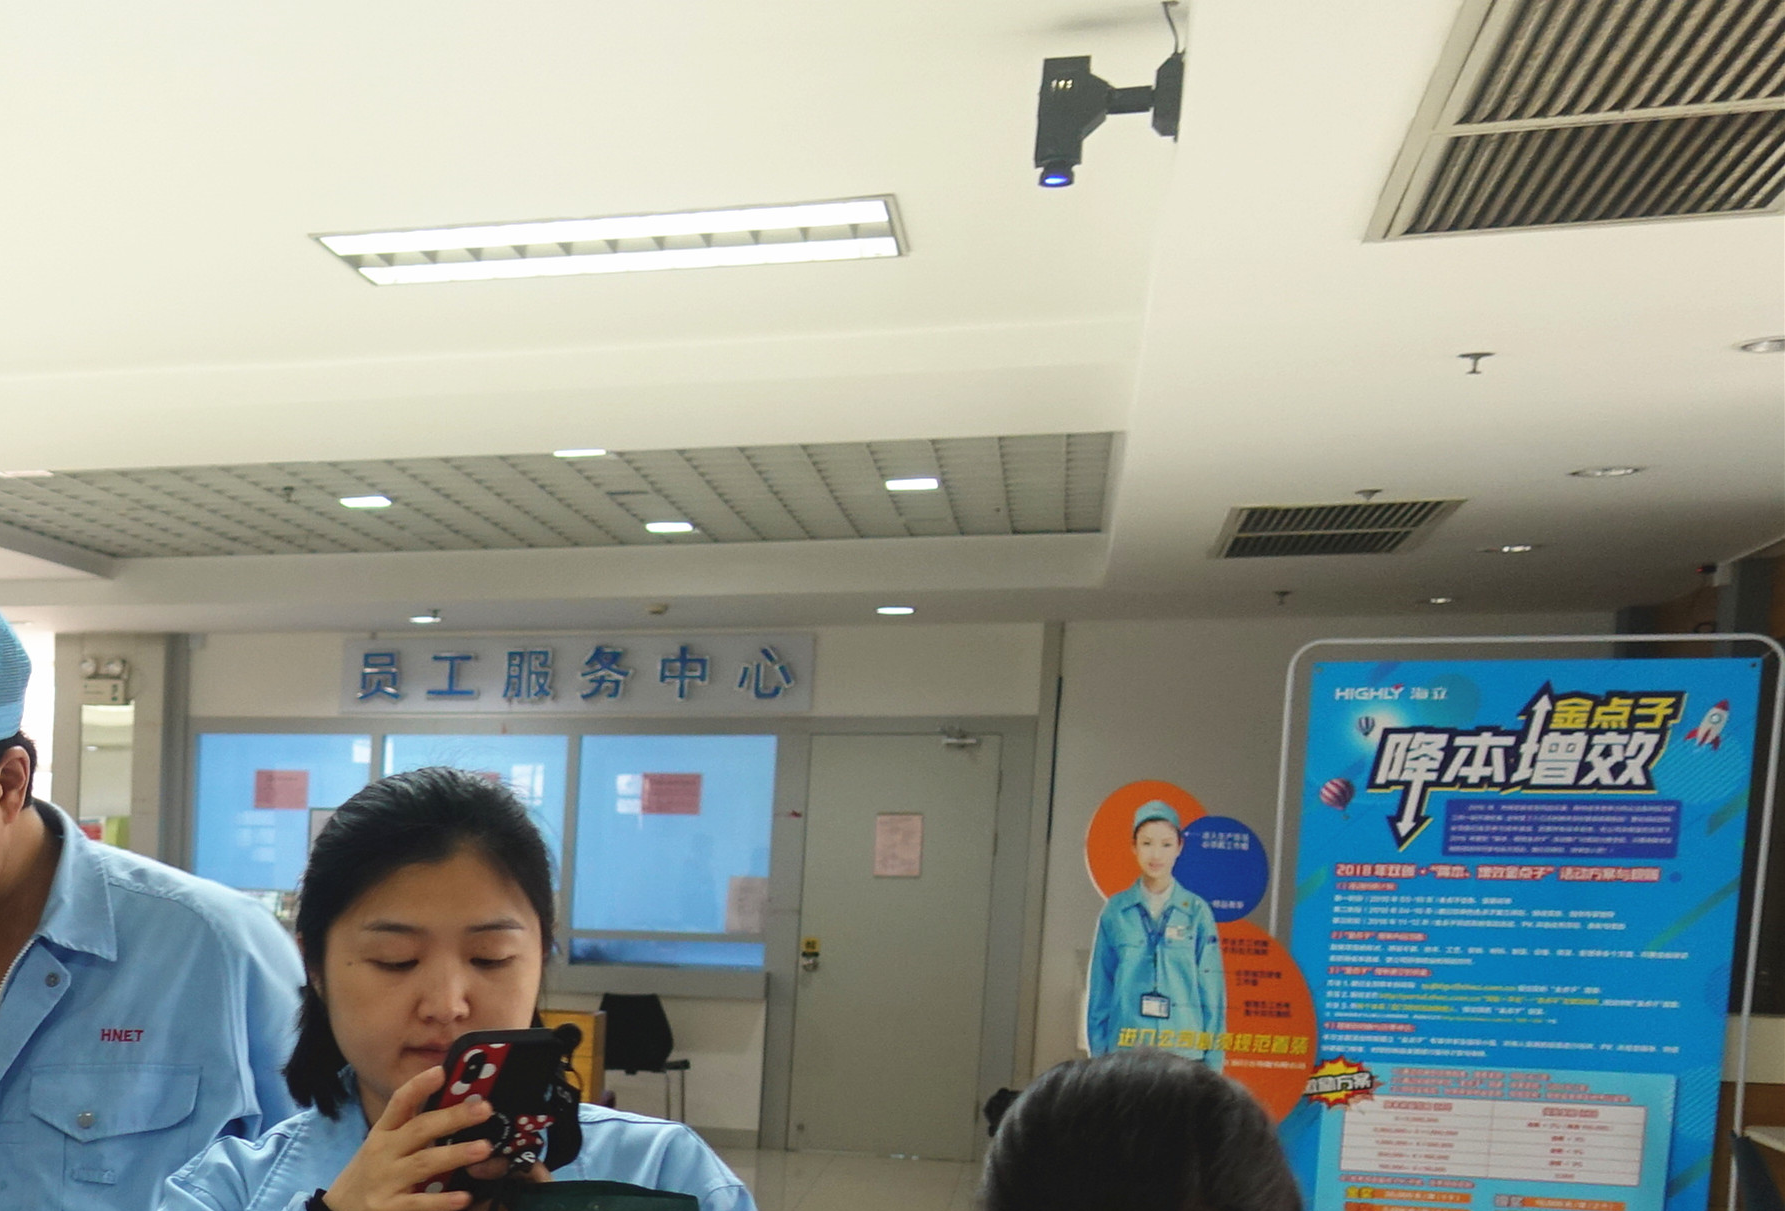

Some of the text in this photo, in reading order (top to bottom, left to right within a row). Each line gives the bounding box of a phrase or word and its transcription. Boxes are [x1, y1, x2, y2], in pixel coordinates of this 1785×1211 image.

[355, 645, 795, 702] 员工服务中心
[1334, 685, 1404, 700] HIGHLY
[1549, 697, 1677, 730] 金点子
[1375, 730, 1661, 787] 降本增效
[100, 1028, 145, 1045] HNET
